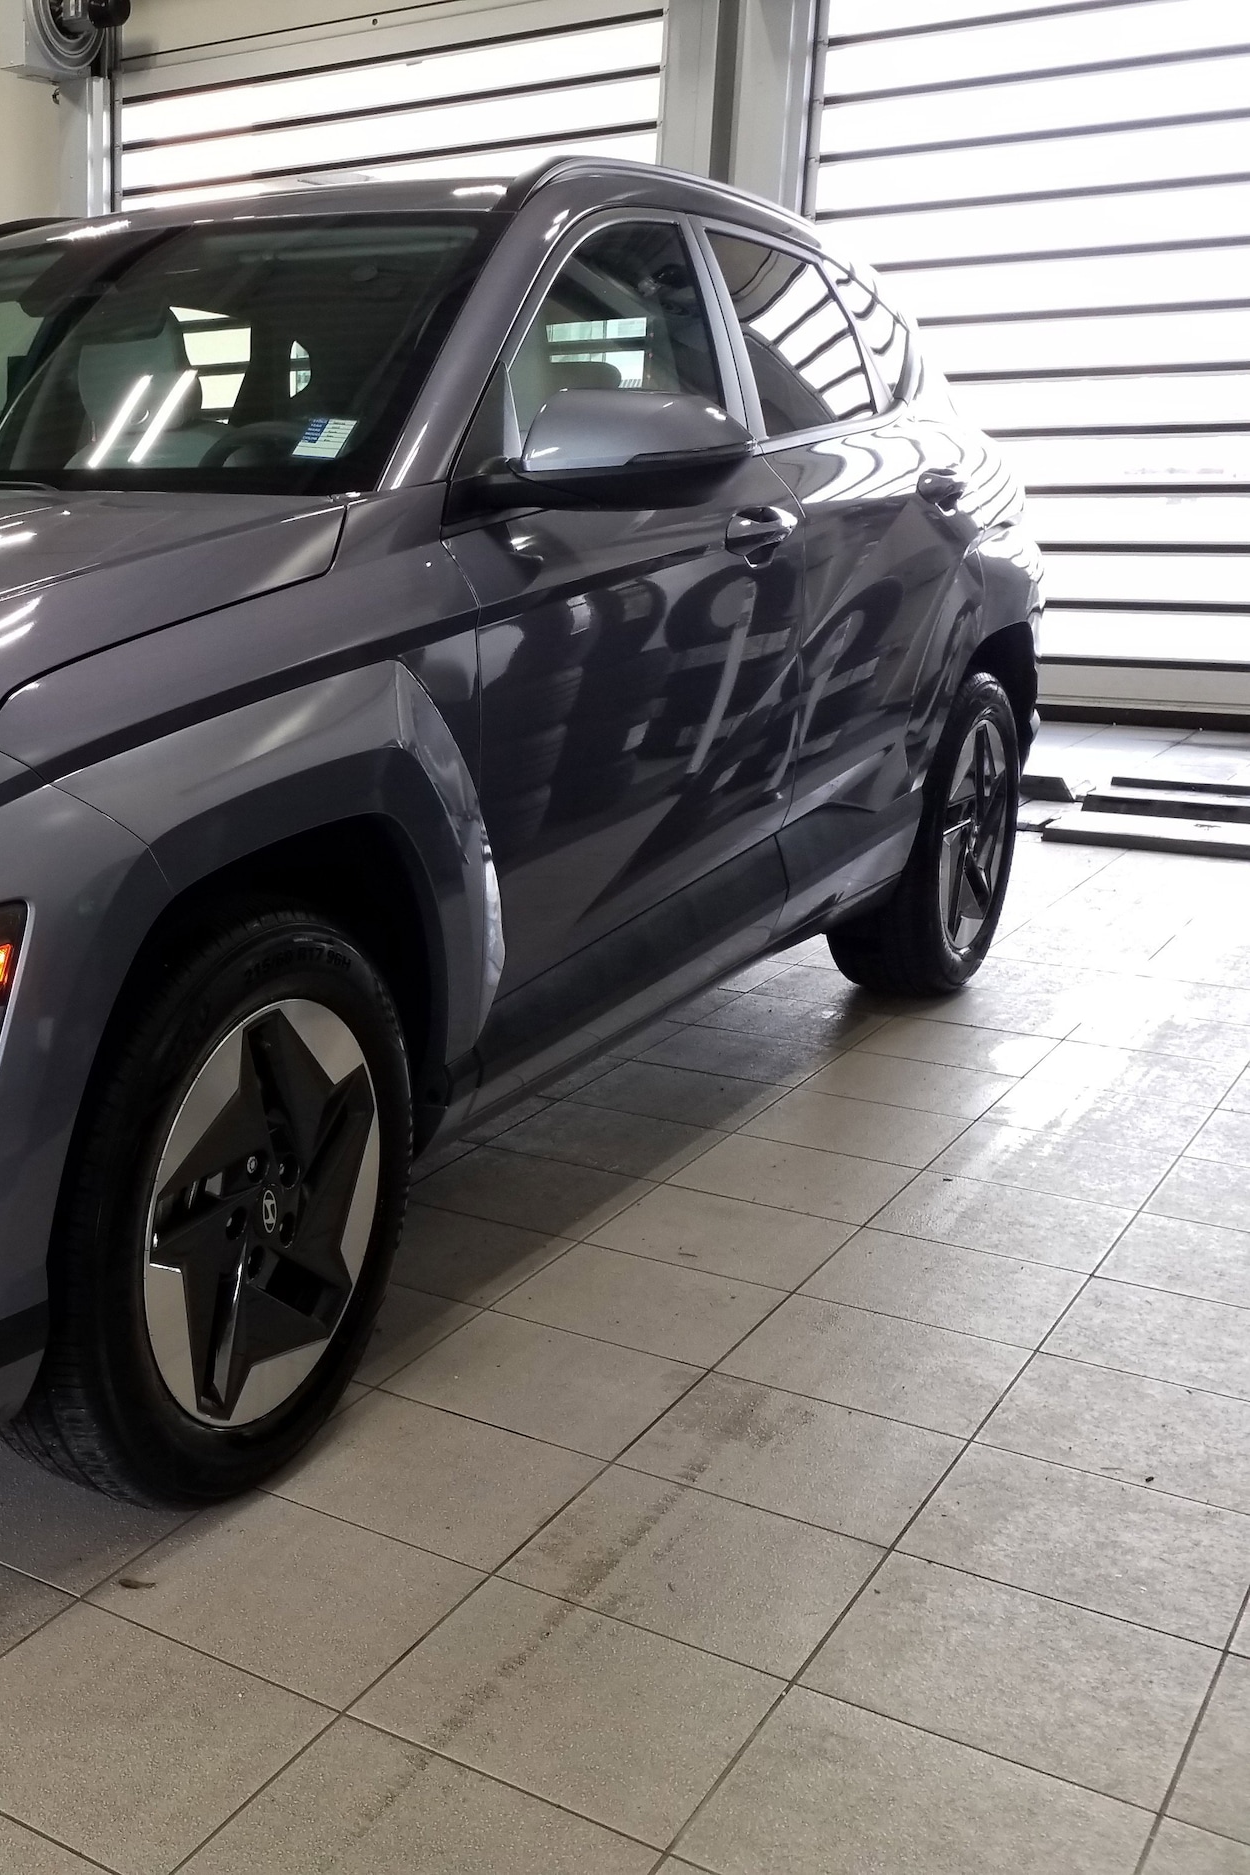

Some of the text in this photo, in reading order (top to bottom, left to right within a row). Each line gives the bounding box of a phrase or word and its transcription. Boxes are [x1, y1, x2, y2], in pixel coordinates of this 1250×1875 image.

[244, 947, 352, 984] 215/60 R17 96H
